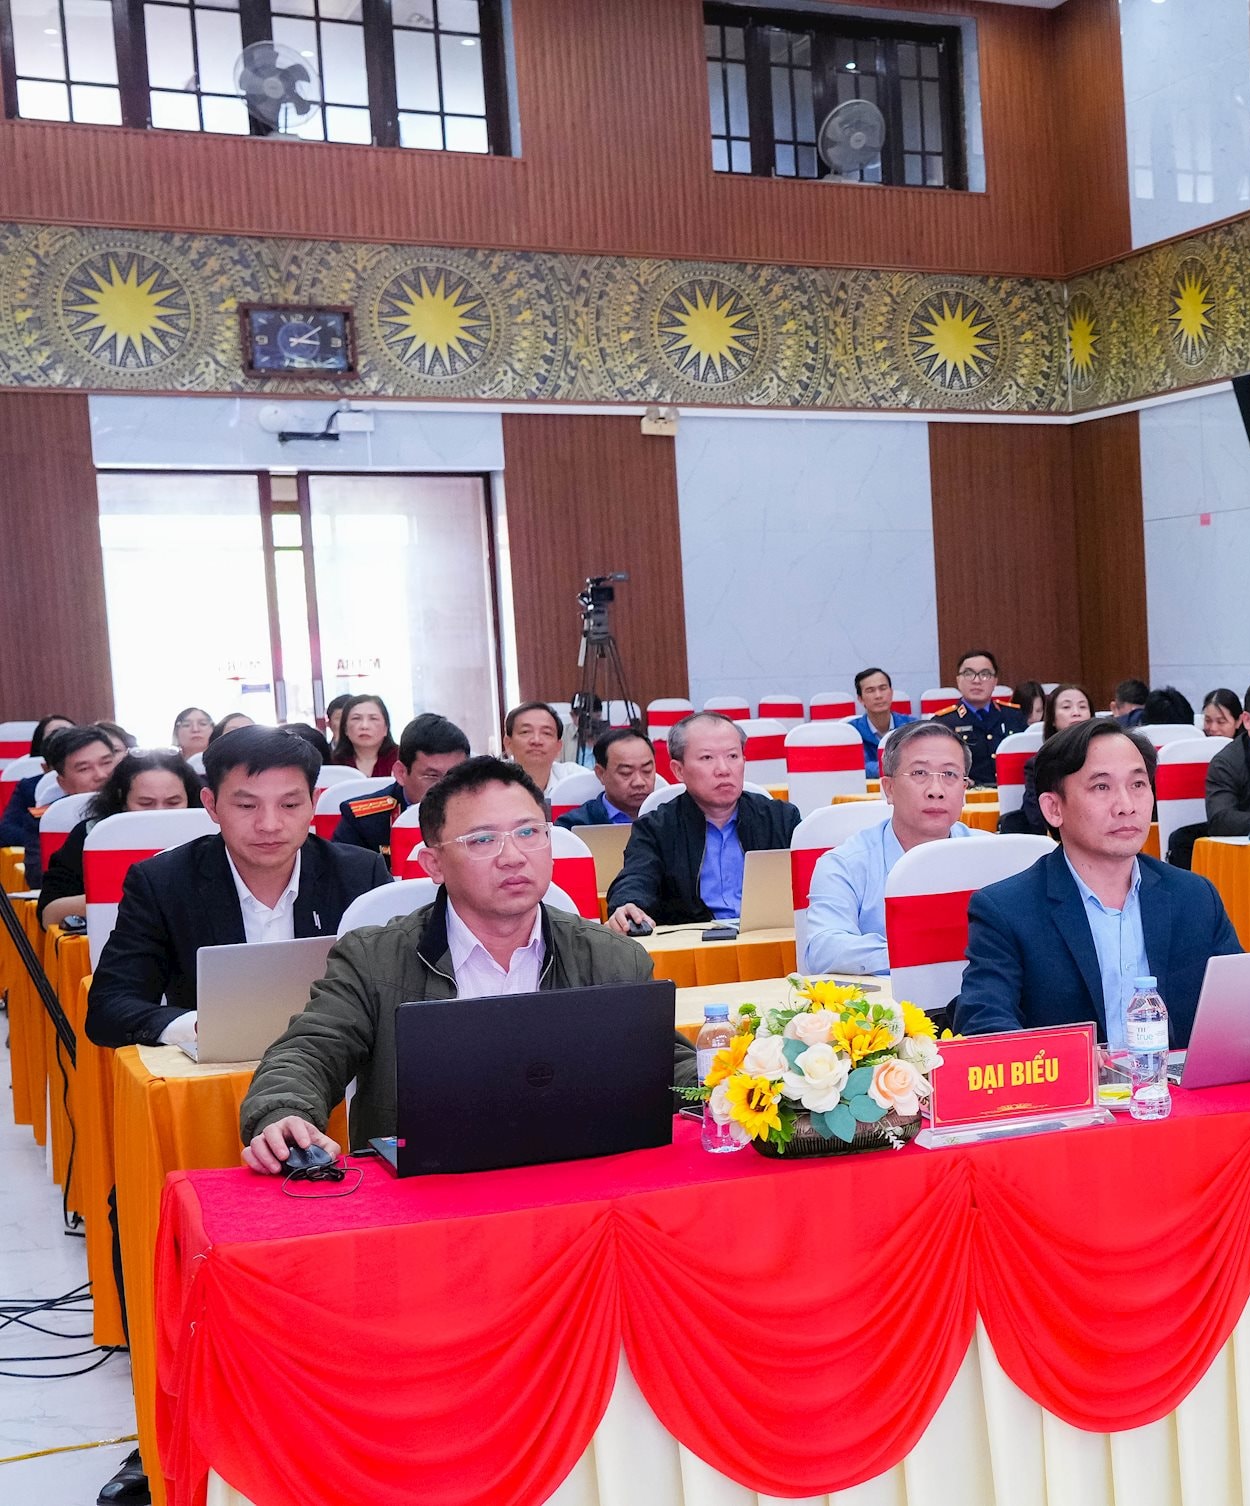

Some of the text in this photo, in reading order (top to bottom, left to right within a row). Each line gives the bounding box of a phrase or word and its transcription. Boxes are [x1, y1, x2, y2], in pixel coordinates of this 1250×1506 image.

[255, 335, 269, 345] 9
[1136, 1033, 1154, 1041] true
[967, 1049, 1059, 1095] ĐẠI BIỂU
